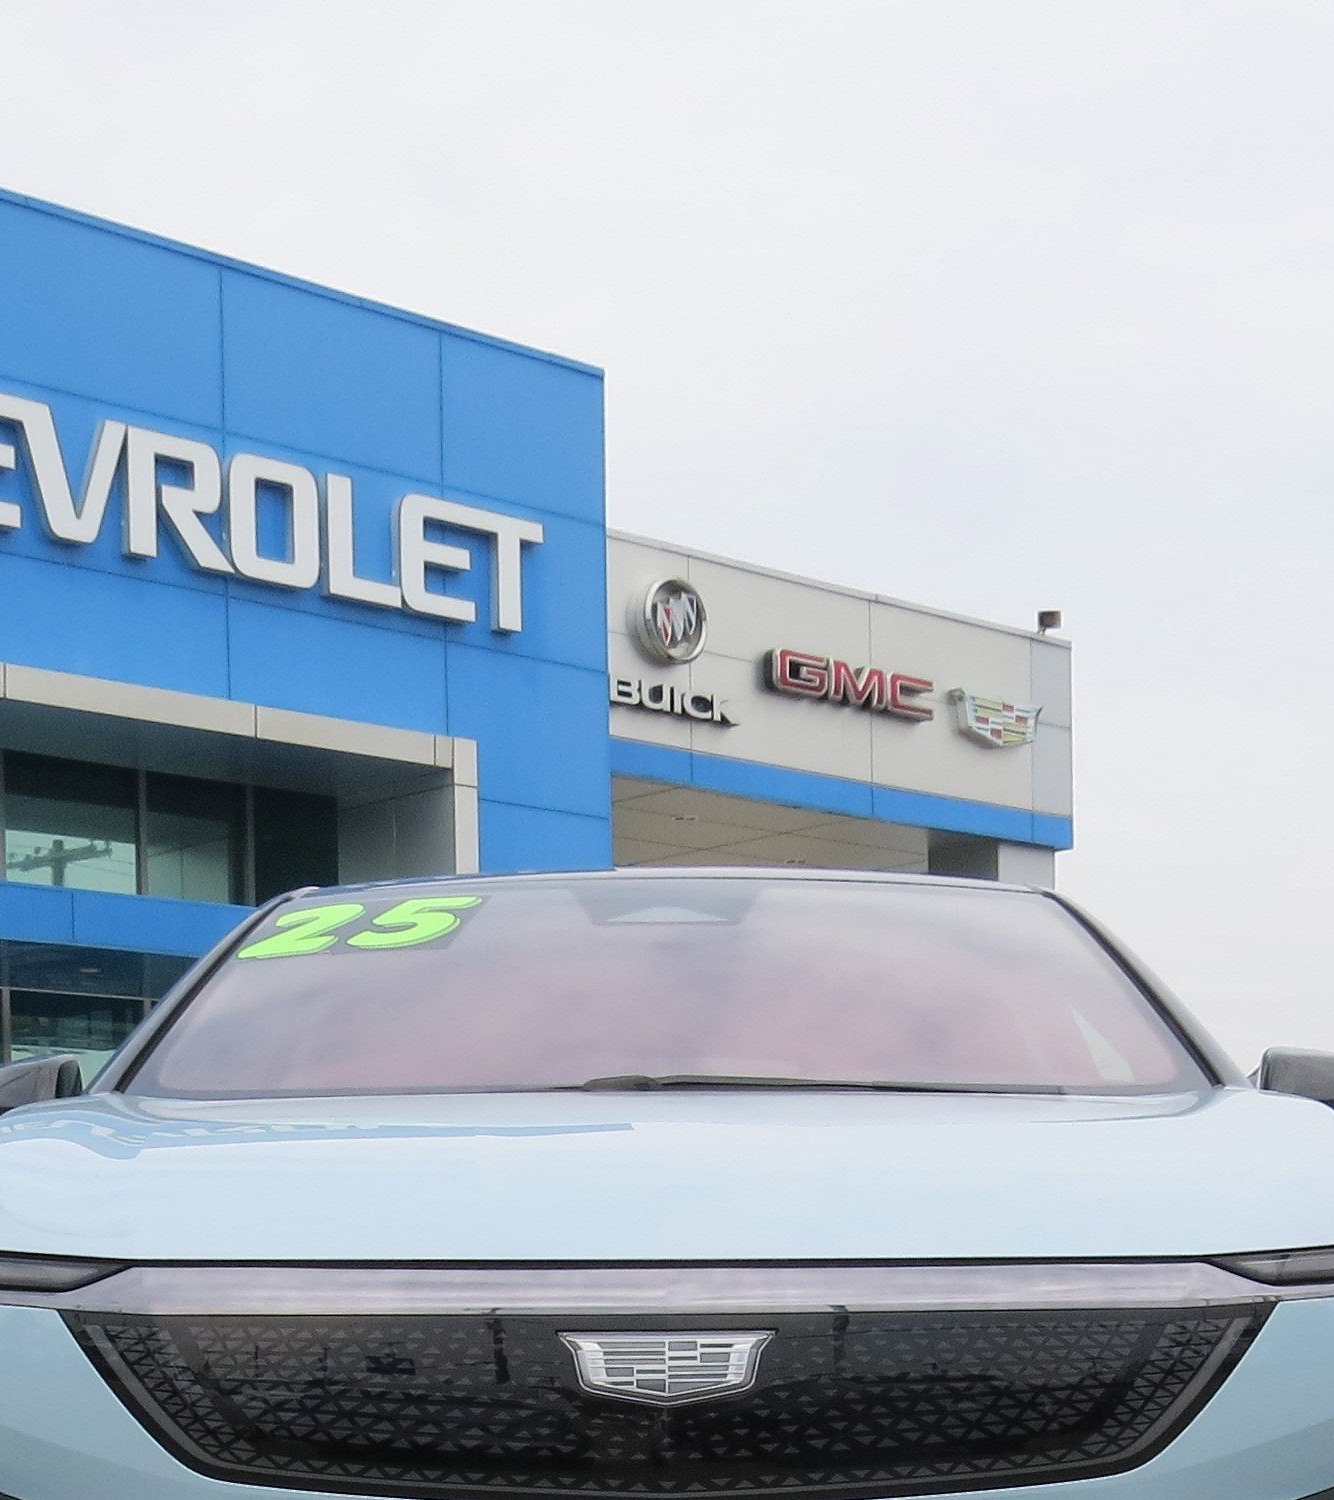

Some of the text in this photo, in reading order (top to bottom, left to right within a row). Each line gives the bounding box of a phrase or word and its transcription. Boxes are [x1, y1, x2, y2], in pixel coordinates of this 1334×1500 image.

[609, 677, 739, 726] BUICK
[769, 647, 935, 721] GMC
[236, 895, 483, 960] 25
